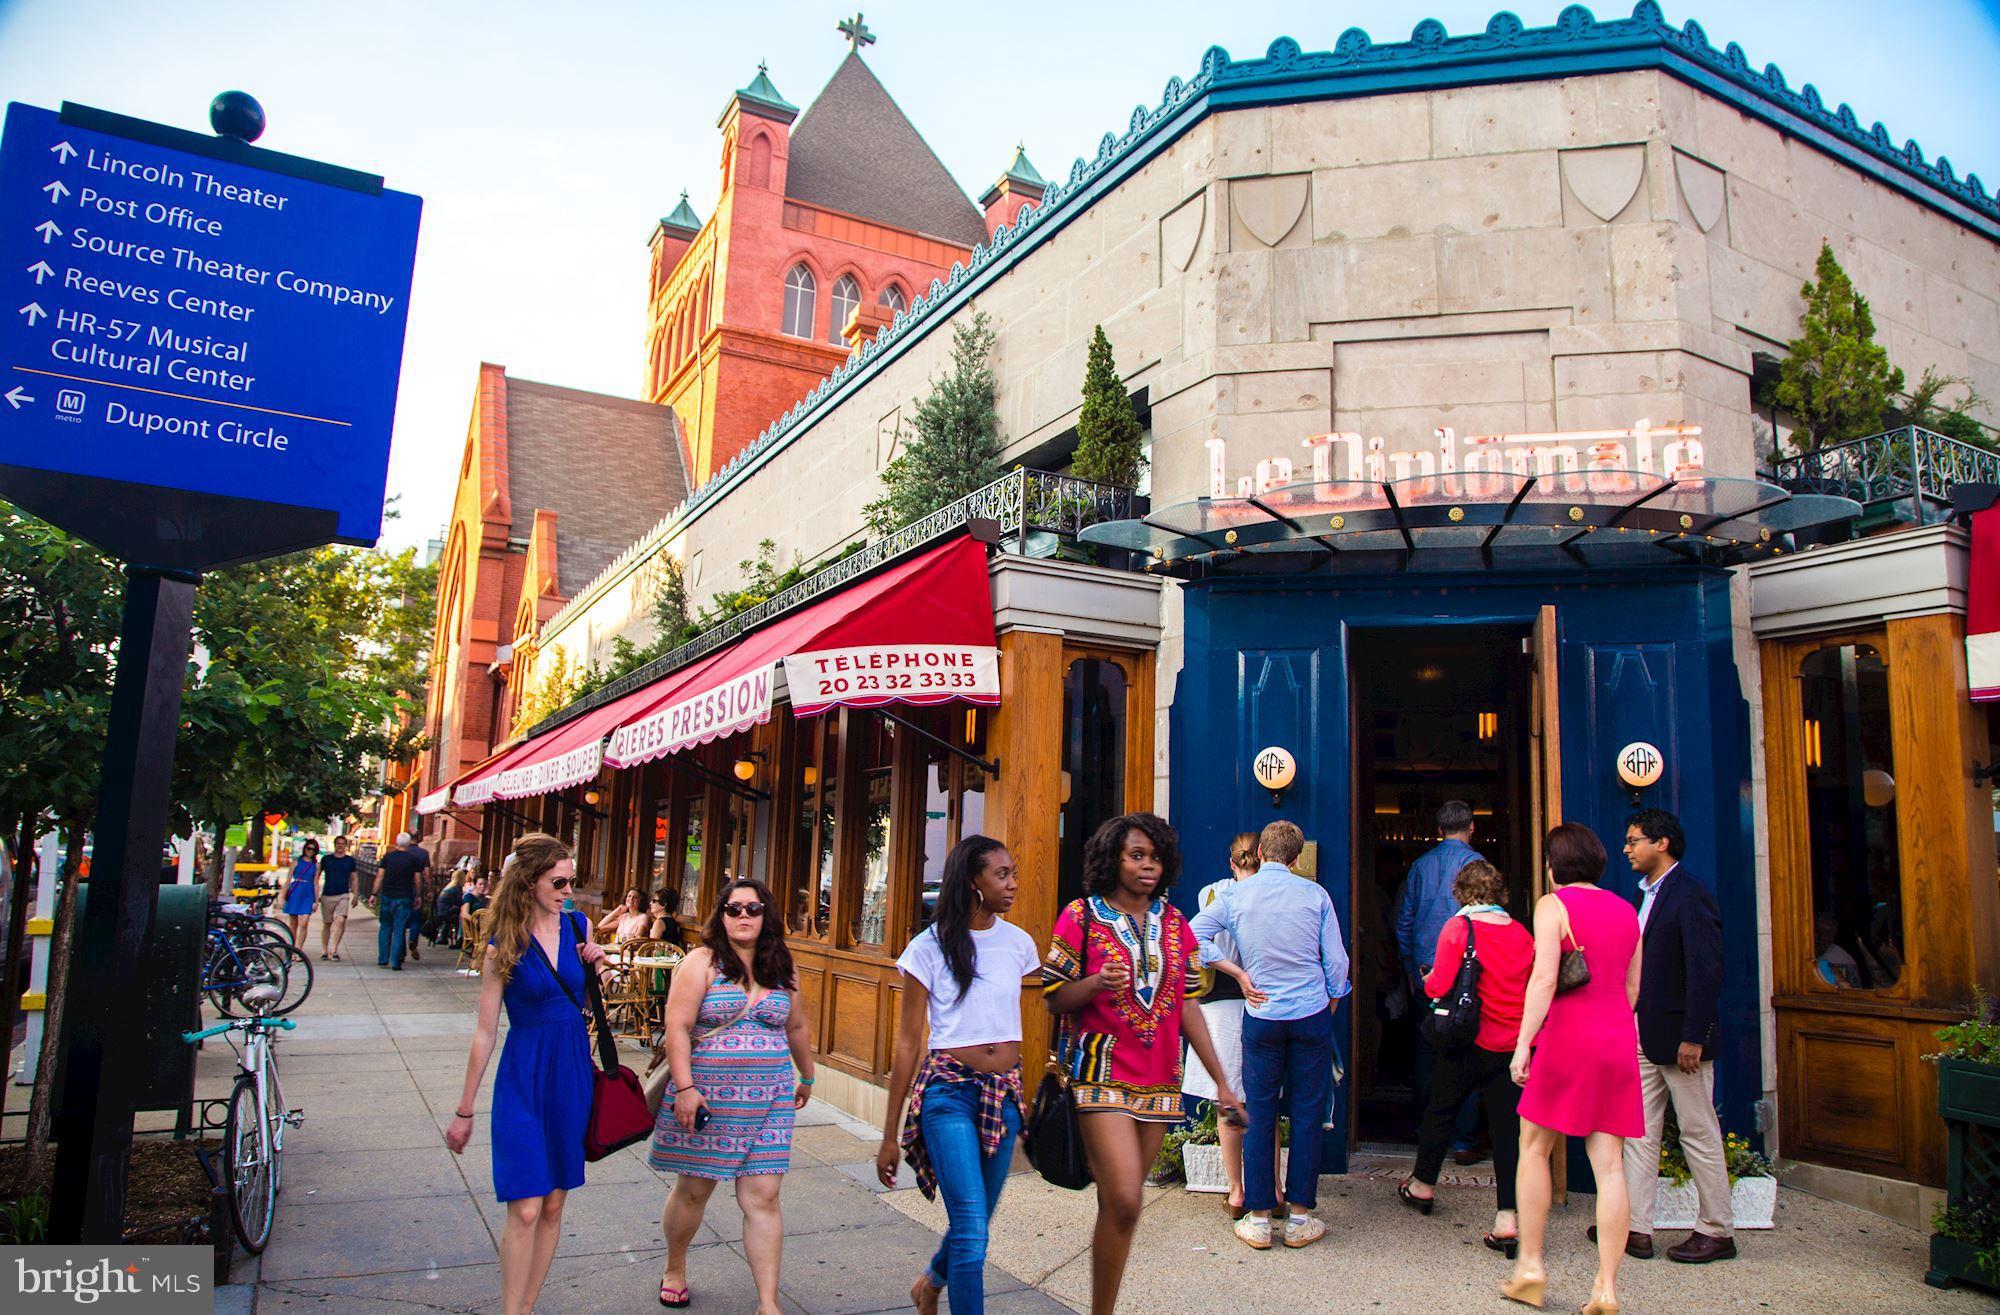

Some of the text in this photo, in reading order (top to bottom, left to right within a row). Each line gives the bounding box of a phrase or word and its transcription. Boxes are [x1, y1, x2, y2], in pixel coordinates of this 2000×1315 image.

[87, 148, 289, 211] Lincoln Theater
[79, 187, 223, 236] Post Office
[64, 267, 255, 322] Reeves Center
[71, 227, 394, 315] Source Theater Company
[56, 308, 248, 363] HR-57 Musical
[51, 338, 256, 392] Cultural Center
[55, 414, 82, 424] metro
[63, 395, 79, 410] M
[105, 402, 289, 451] Dupont Circle
[1205, 418, 1704, 504] Le Diplomate
[815, 652, 974, 674] TÉLÉPHONE
[818, 672, 976, 696] 20 23 32 33 33
[671, 670, 768, 741] PRESSION
[566, 745, 599, 776] SOUPER
[1626, 747, 1657, 778] BAR
